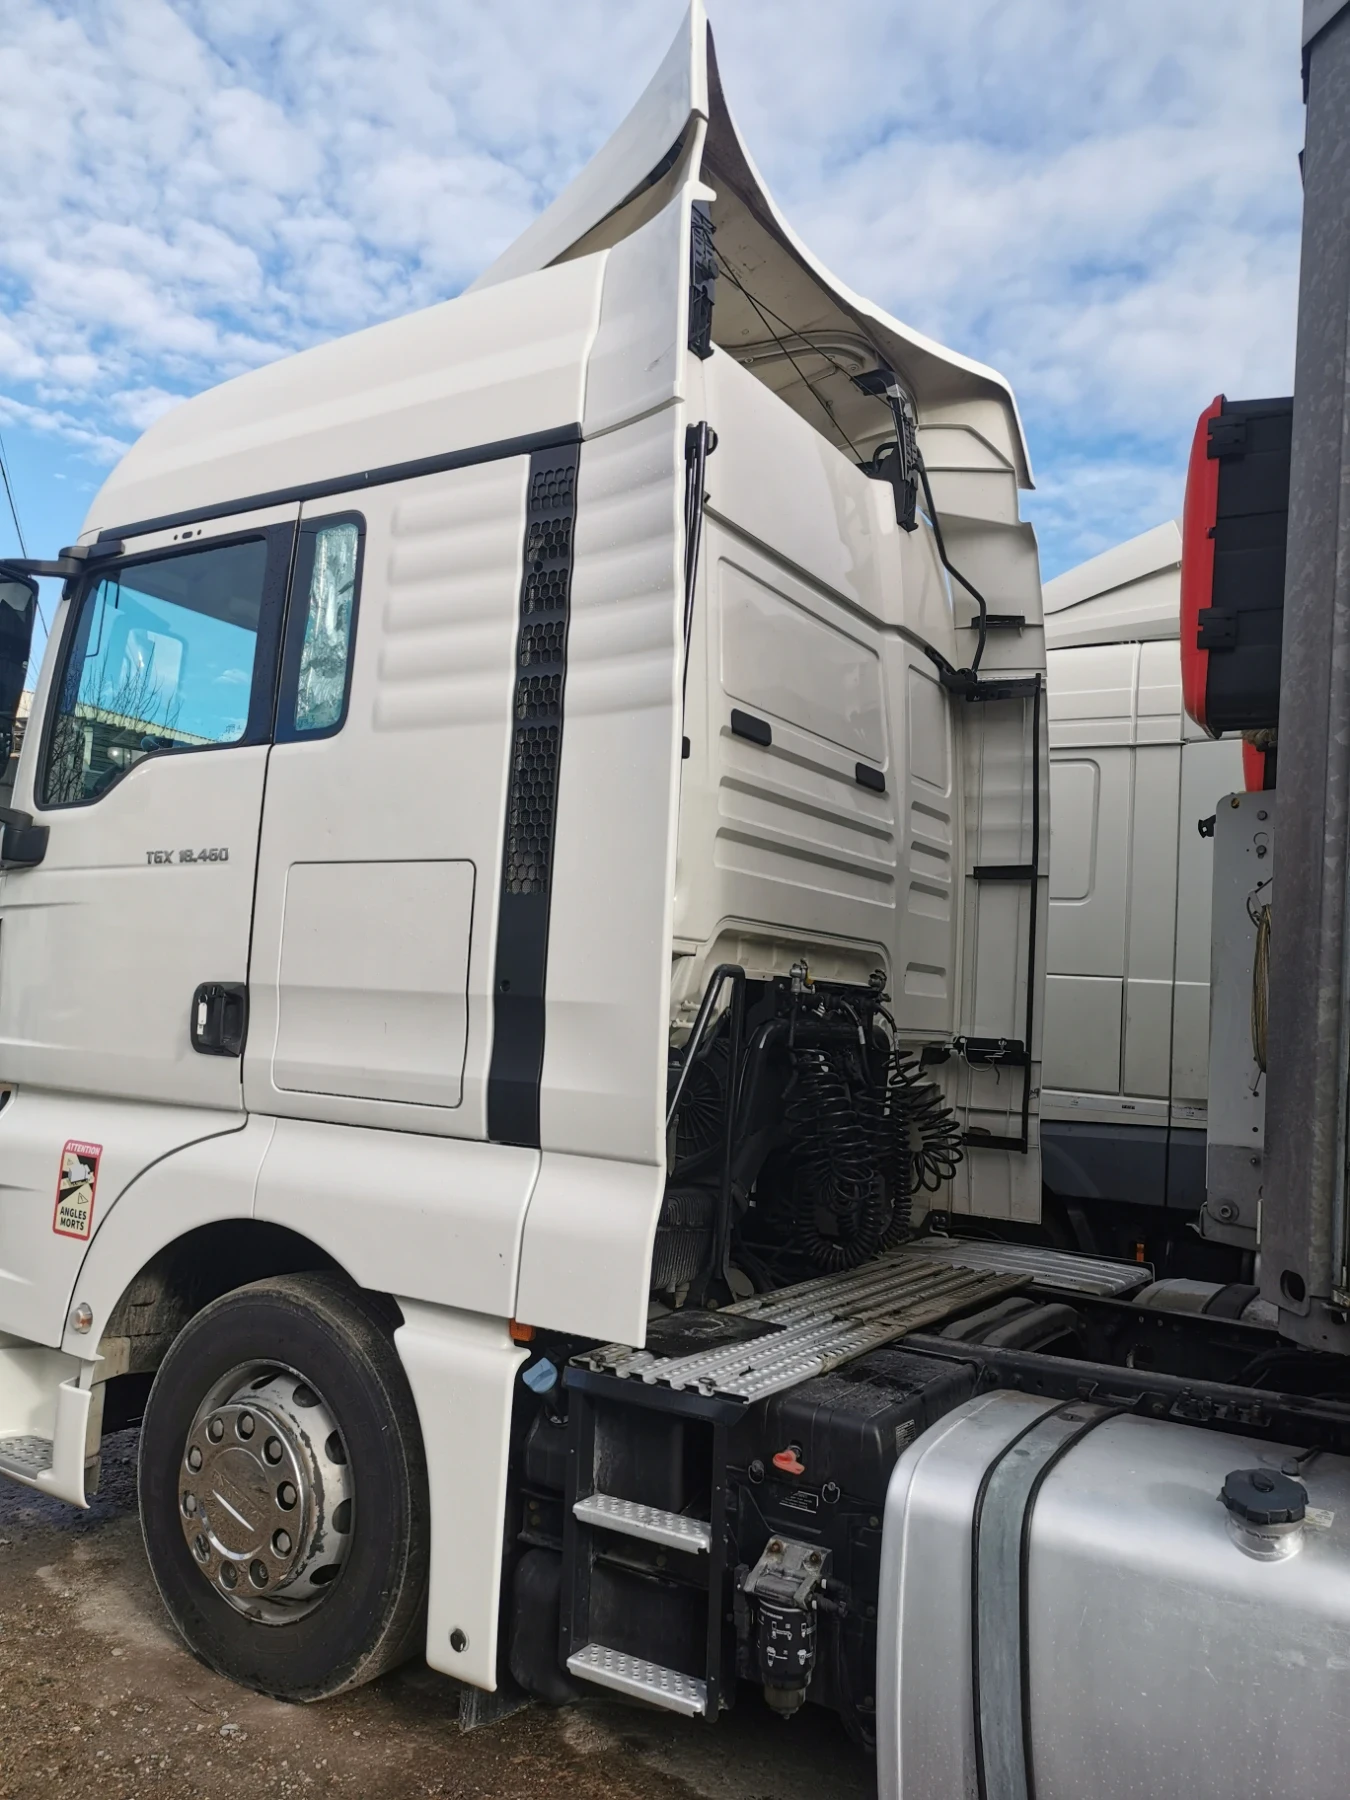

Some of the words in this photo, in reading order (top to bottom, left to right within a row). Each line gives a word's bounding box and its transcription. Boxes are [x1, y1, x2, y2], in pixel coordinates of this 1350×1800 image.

[146, 850, 174, 865] TGX
[179, 847, 229, 863] 18.460
[65, 1142, 101, 1156] ATTENTION
[60, 1206, 87, 1220] ANGLES
[60, 1218, 85, 1231] MORTS
